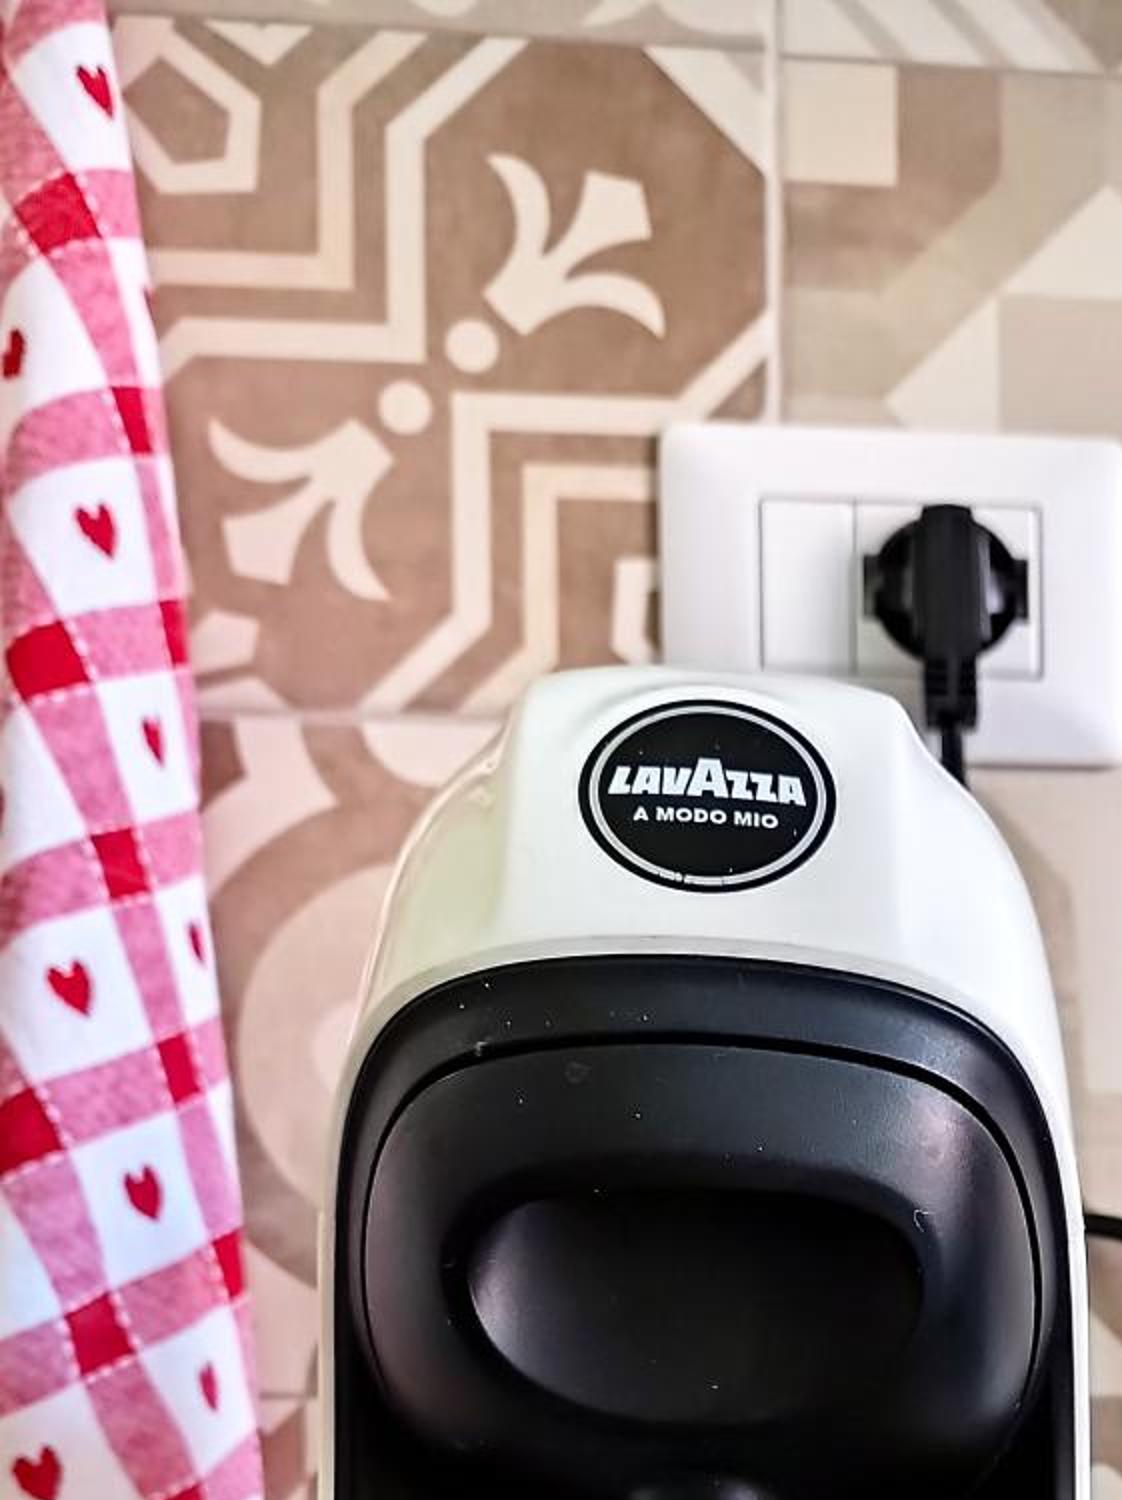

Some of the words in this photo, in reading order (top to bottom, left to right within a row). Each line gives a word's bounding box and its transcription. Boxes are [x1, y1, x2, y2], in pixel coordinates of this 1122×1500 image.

[607, 757, 806, 807] LAVAZZA
[633, 806, 649, 821] A
[655, 806, 727, 824] MODO
[733, 811, 779, 829] MIO
